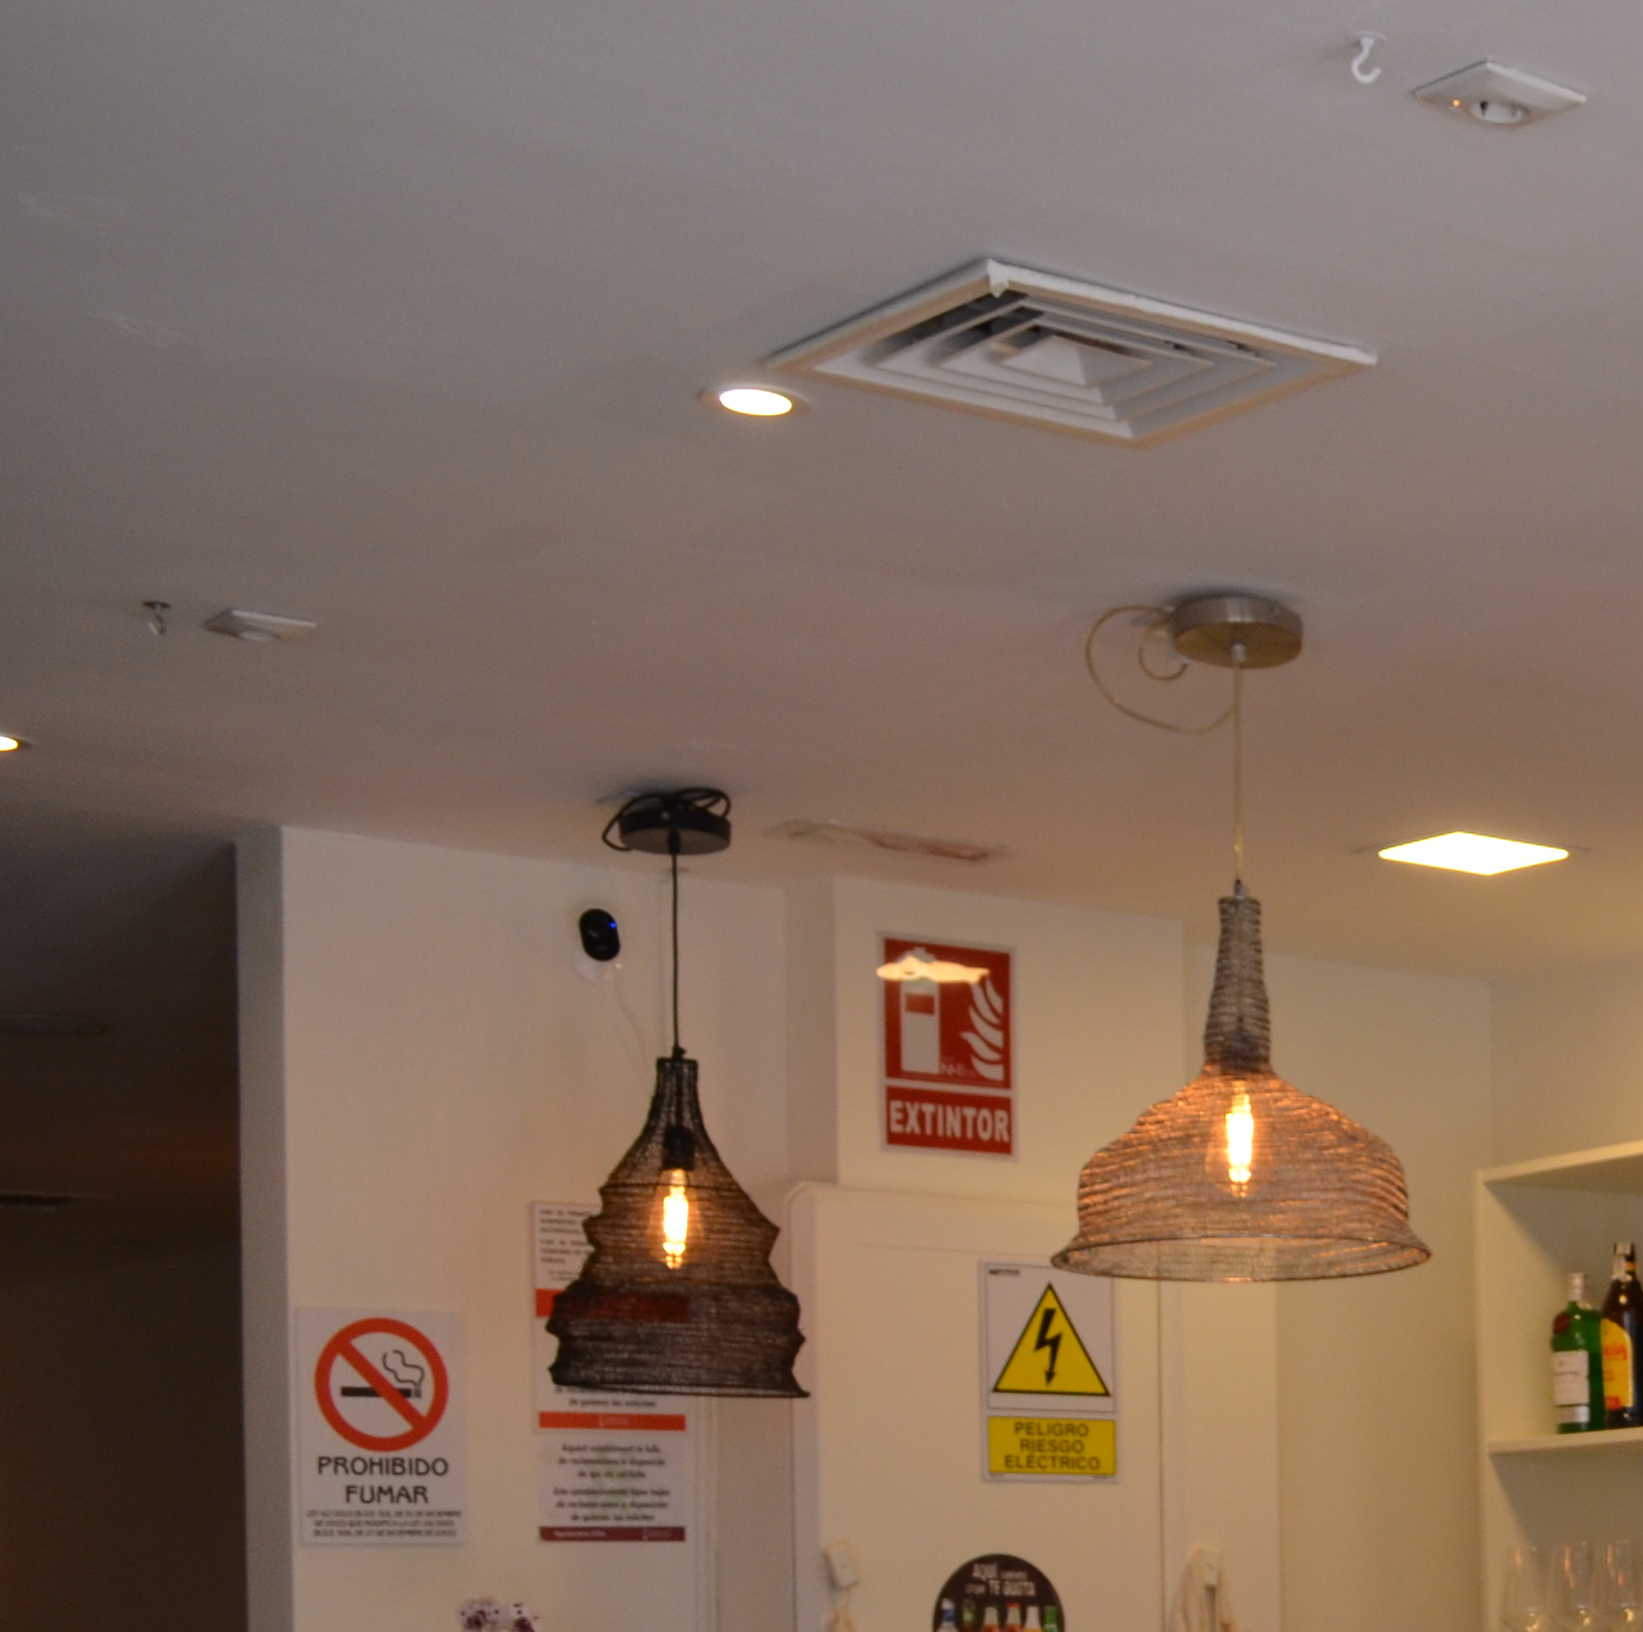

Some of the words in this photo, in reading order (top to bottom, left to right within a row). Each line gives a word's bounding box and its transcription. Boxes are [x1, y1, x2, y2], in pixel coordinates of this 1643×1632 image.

[890, 1100, 1010, 1142] EXTINTOR
[1013, 1421, 1090, 1438] PELIGRO
[1019, 1438, 1085, 1454] RIESGO
[316, 1456, 449, 1477] PROHIBIDO
[345, 1484, 430, 1505] FUMAR
